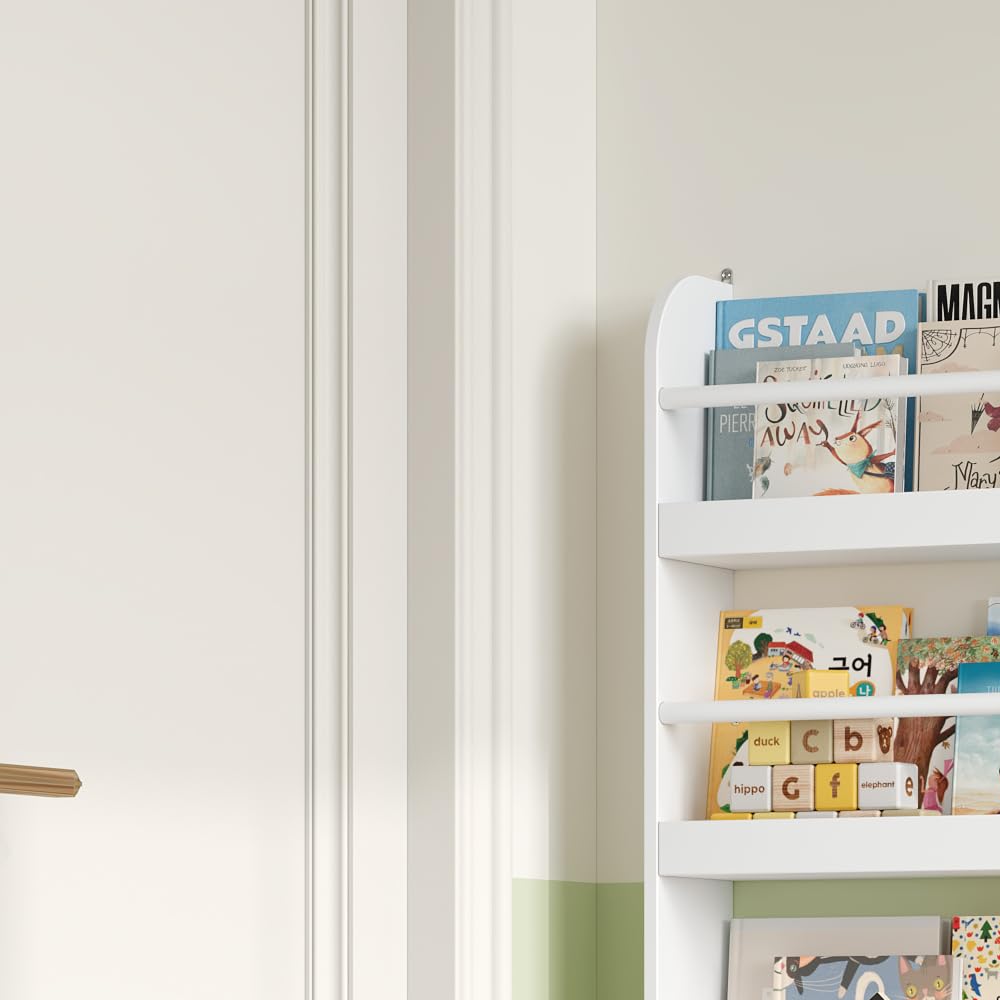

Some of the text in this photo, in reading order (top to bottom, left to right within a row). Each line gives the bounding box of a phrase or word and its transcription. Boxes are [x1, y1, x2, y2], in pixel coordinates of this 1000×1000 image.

[728, 311, 906, 349] GSTAAD
[760, 419, 829, 447] AWAY
[952, 461, 997, 490] Mary
[754, 736, 780, 746] duck
[844, 727, 863, 751] b
[734, 784, 765, 795] hippo
[782, 776, 800, 800] G
[830, 772, 841, 798] f
[861, 781, 895, 790] elephant
[905, 777, 914, 796] e
